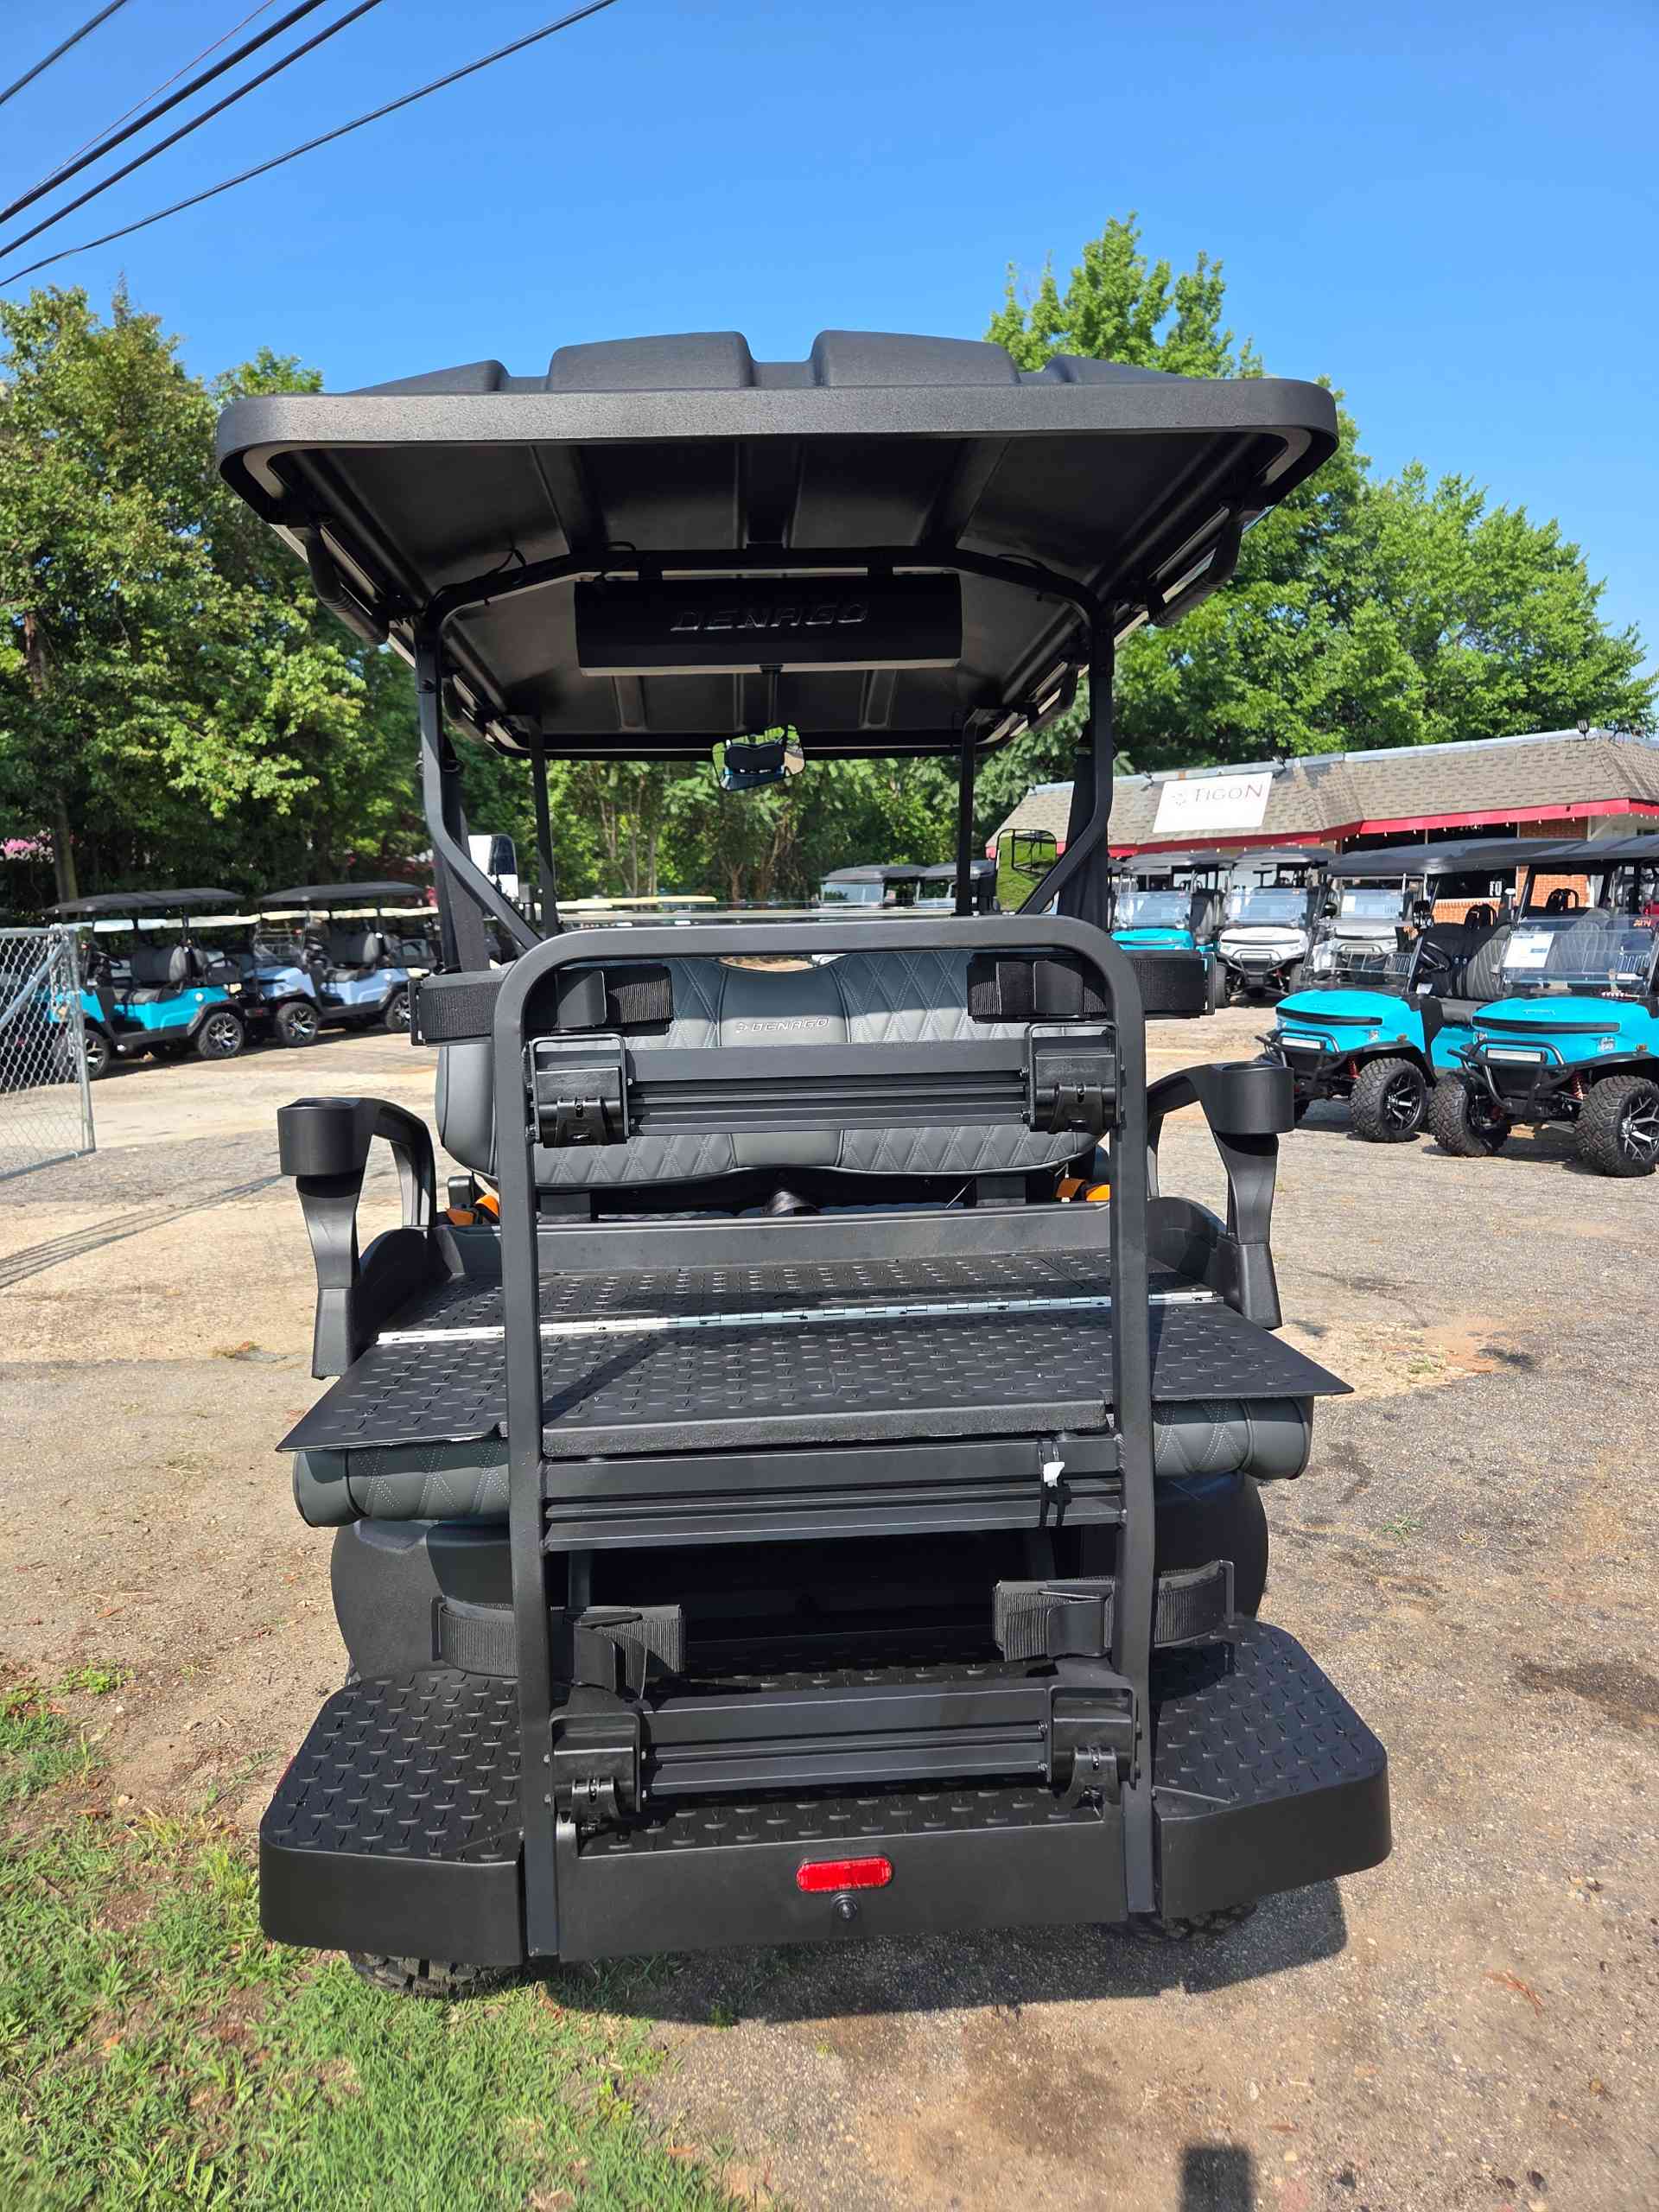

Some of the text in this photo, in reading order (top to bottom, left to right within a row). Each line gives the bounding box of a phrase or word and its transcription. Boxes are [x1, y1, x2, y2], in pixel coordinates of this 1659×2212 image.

[670, 604, 868, 632] DENAGO
[1194, 783, 1264, 803] TIGON
[751, 1016, 830, 1033] DENAGO
